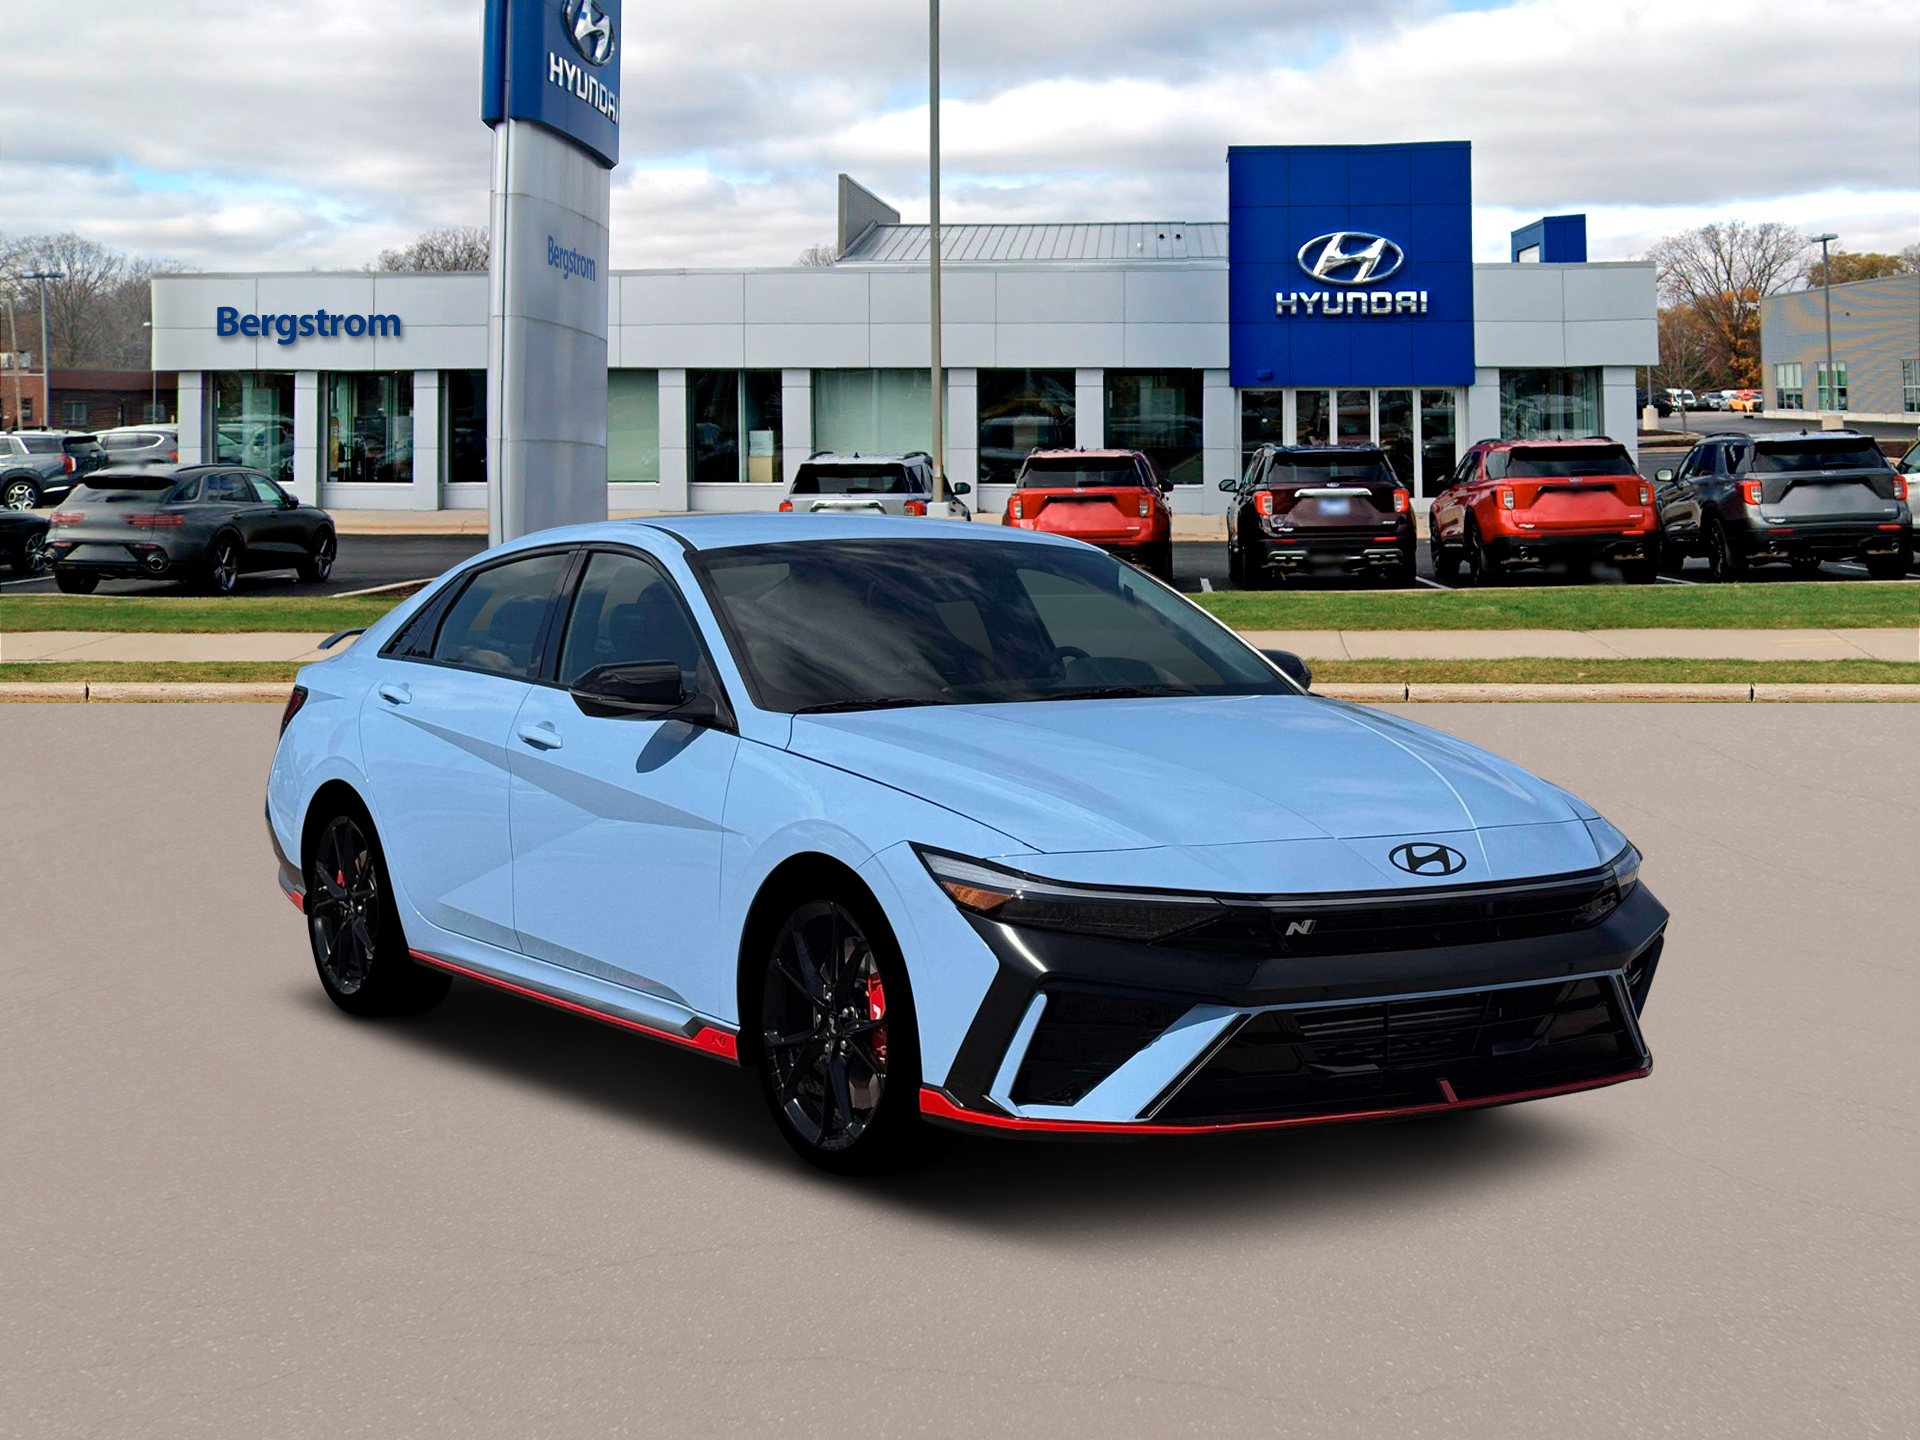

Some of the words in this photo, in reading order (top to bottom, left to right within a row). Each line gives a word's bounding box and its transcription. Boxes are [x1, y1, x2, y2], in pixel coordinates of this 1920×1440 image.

[549, 52, 618, 124] HYUNDAI
[548, 235, 595, 282] Bergstrom
[1276, 291, 1427, 314] HYUNDAI
[217, 306, 401, 346] Bergstrom
